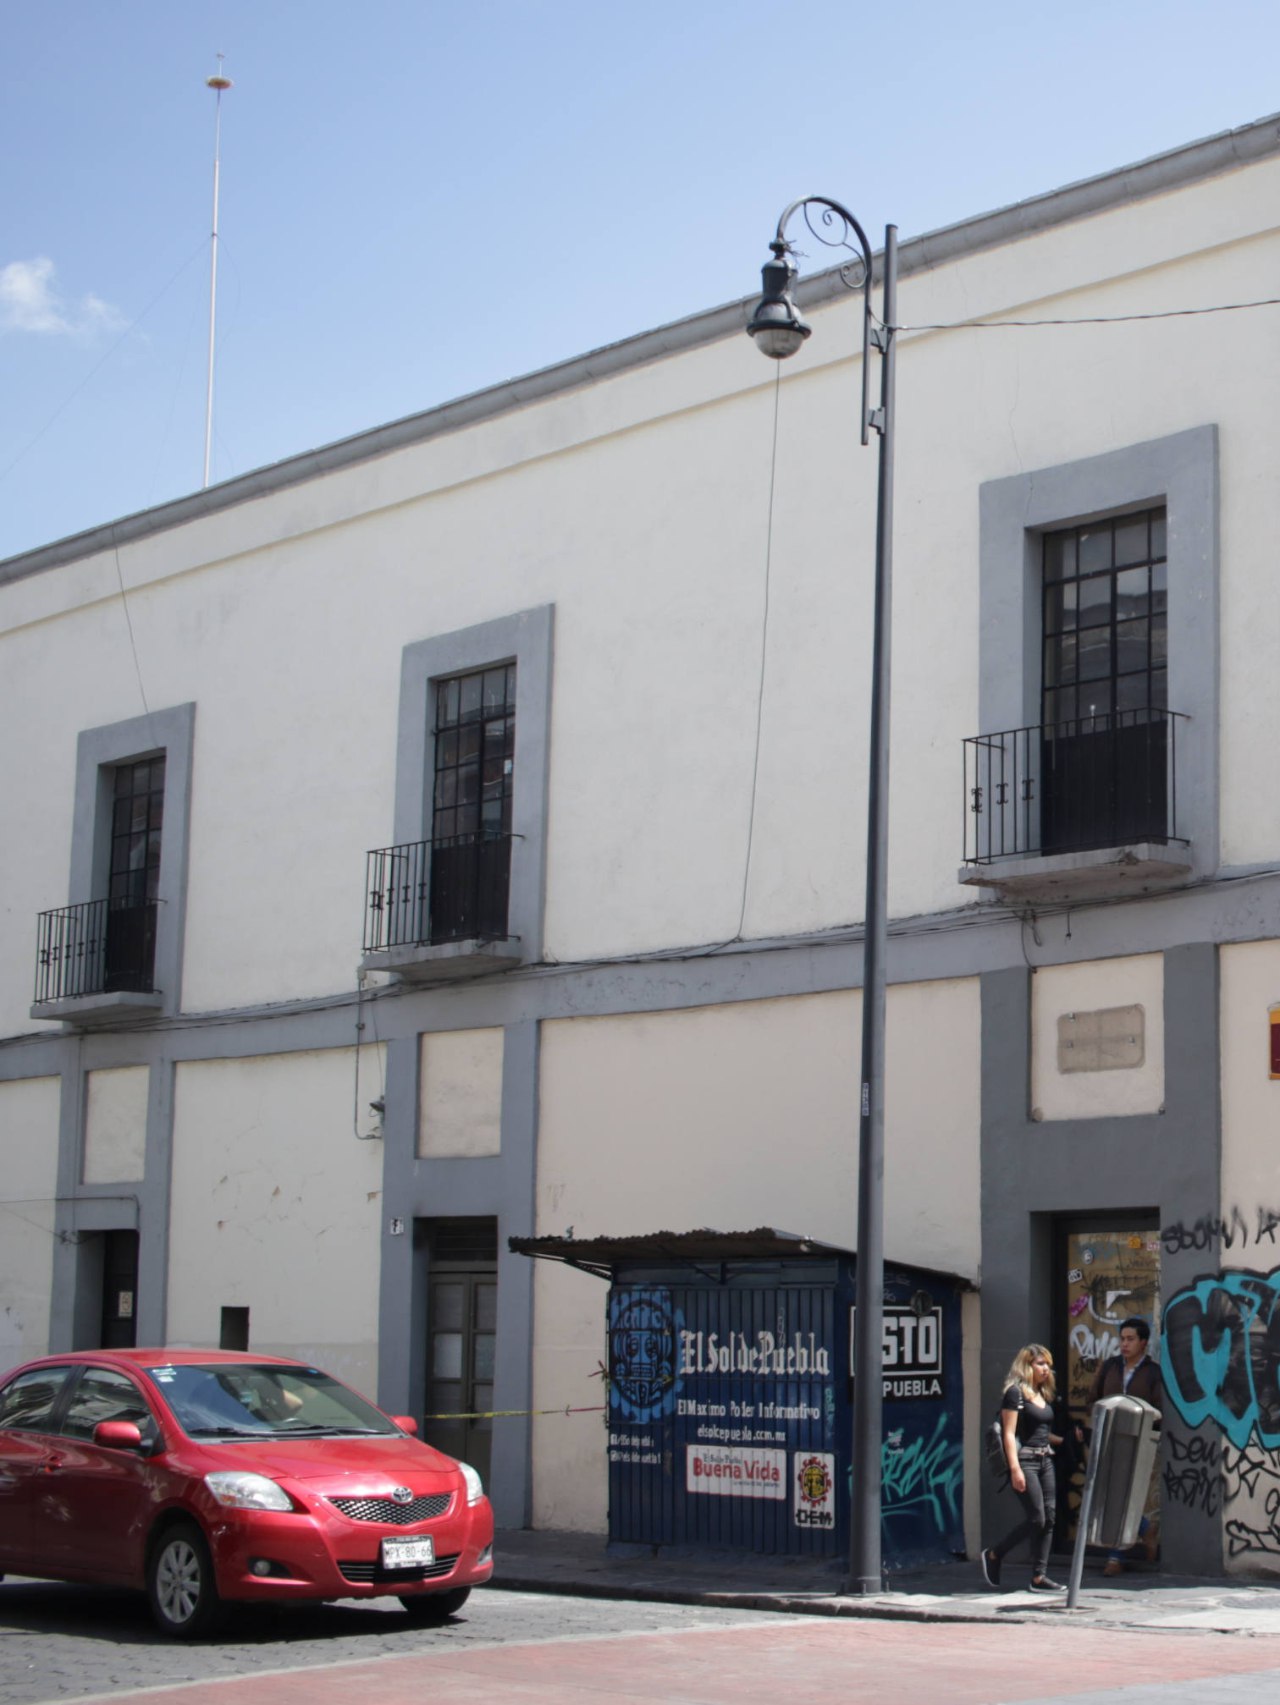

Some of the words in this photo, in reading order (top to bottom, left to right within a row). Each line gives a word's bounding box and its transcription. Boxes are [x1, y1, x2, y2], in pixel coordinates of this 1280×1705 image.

[680, 1330, 703, 1375] El
[704, 1331, 736, 1374] Sol
[737, 1333, 758, 1374] de
[757, 1330, 831, 1376] Puebla
[882, 1316, 937, 1366] STO
[882, 1378, 942, 1398] PUEBLA
[758, 1402, 821, 1420] Informativo
[693, 1456, 742, 1479] Buena
[743, 1460, 780, 1482] Vida
